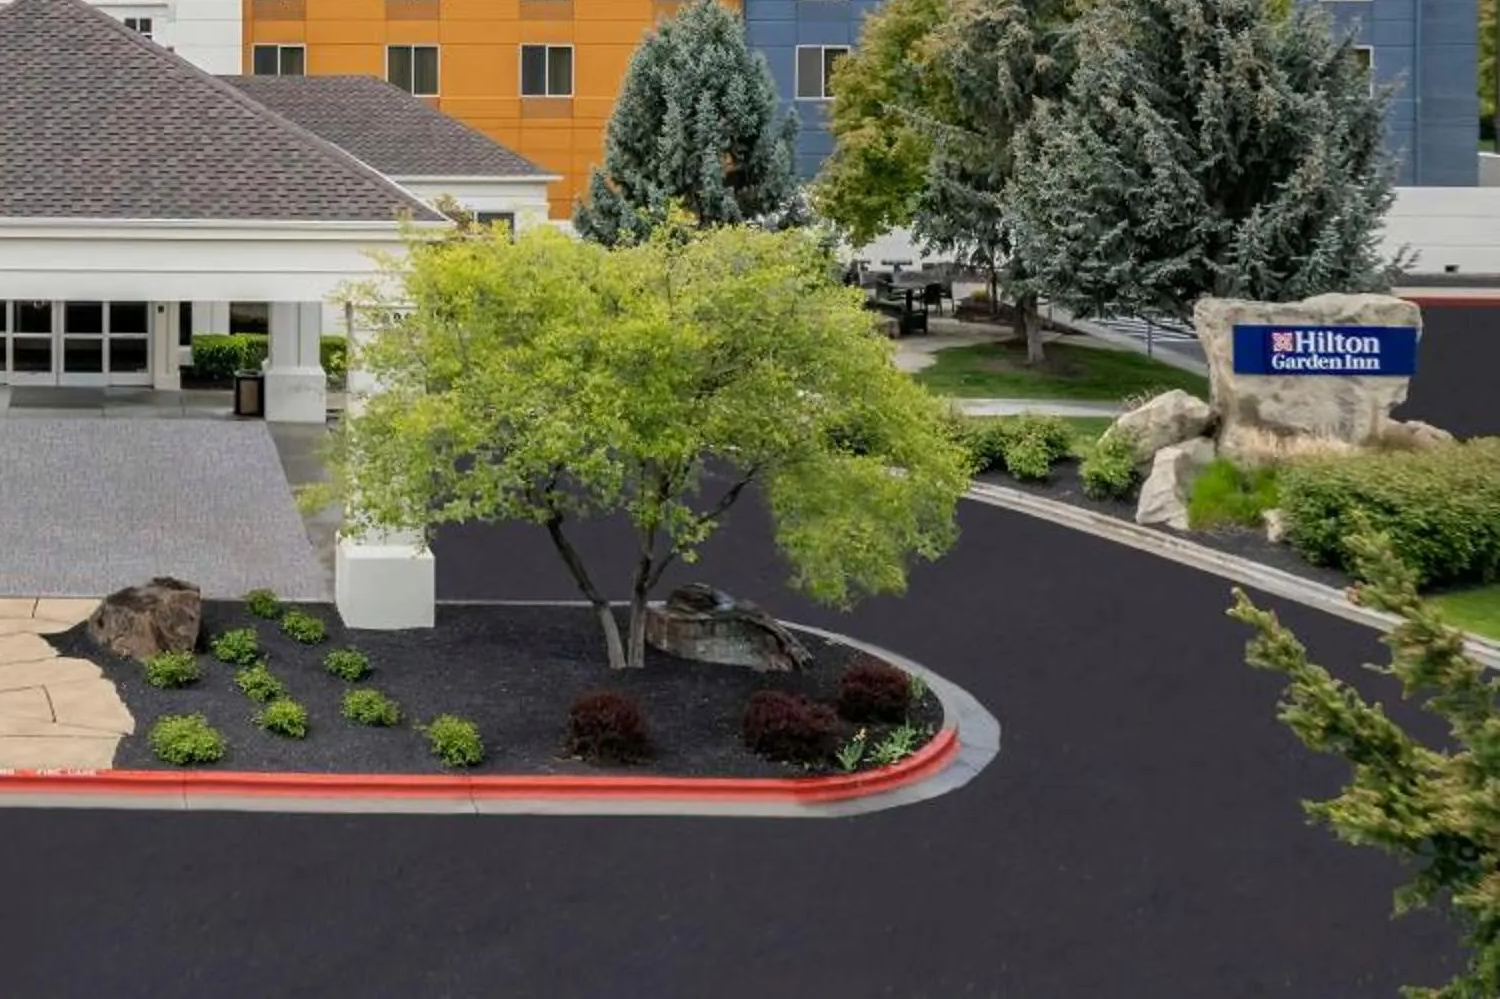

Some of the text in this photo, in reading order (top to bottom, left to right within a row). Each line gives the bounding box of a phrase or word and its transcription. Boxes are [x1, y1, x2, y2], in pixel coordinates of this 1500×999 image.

[1296, 331, 1380, 353] Hilton
[1272, 354, 1380, 369] Garden Inn
